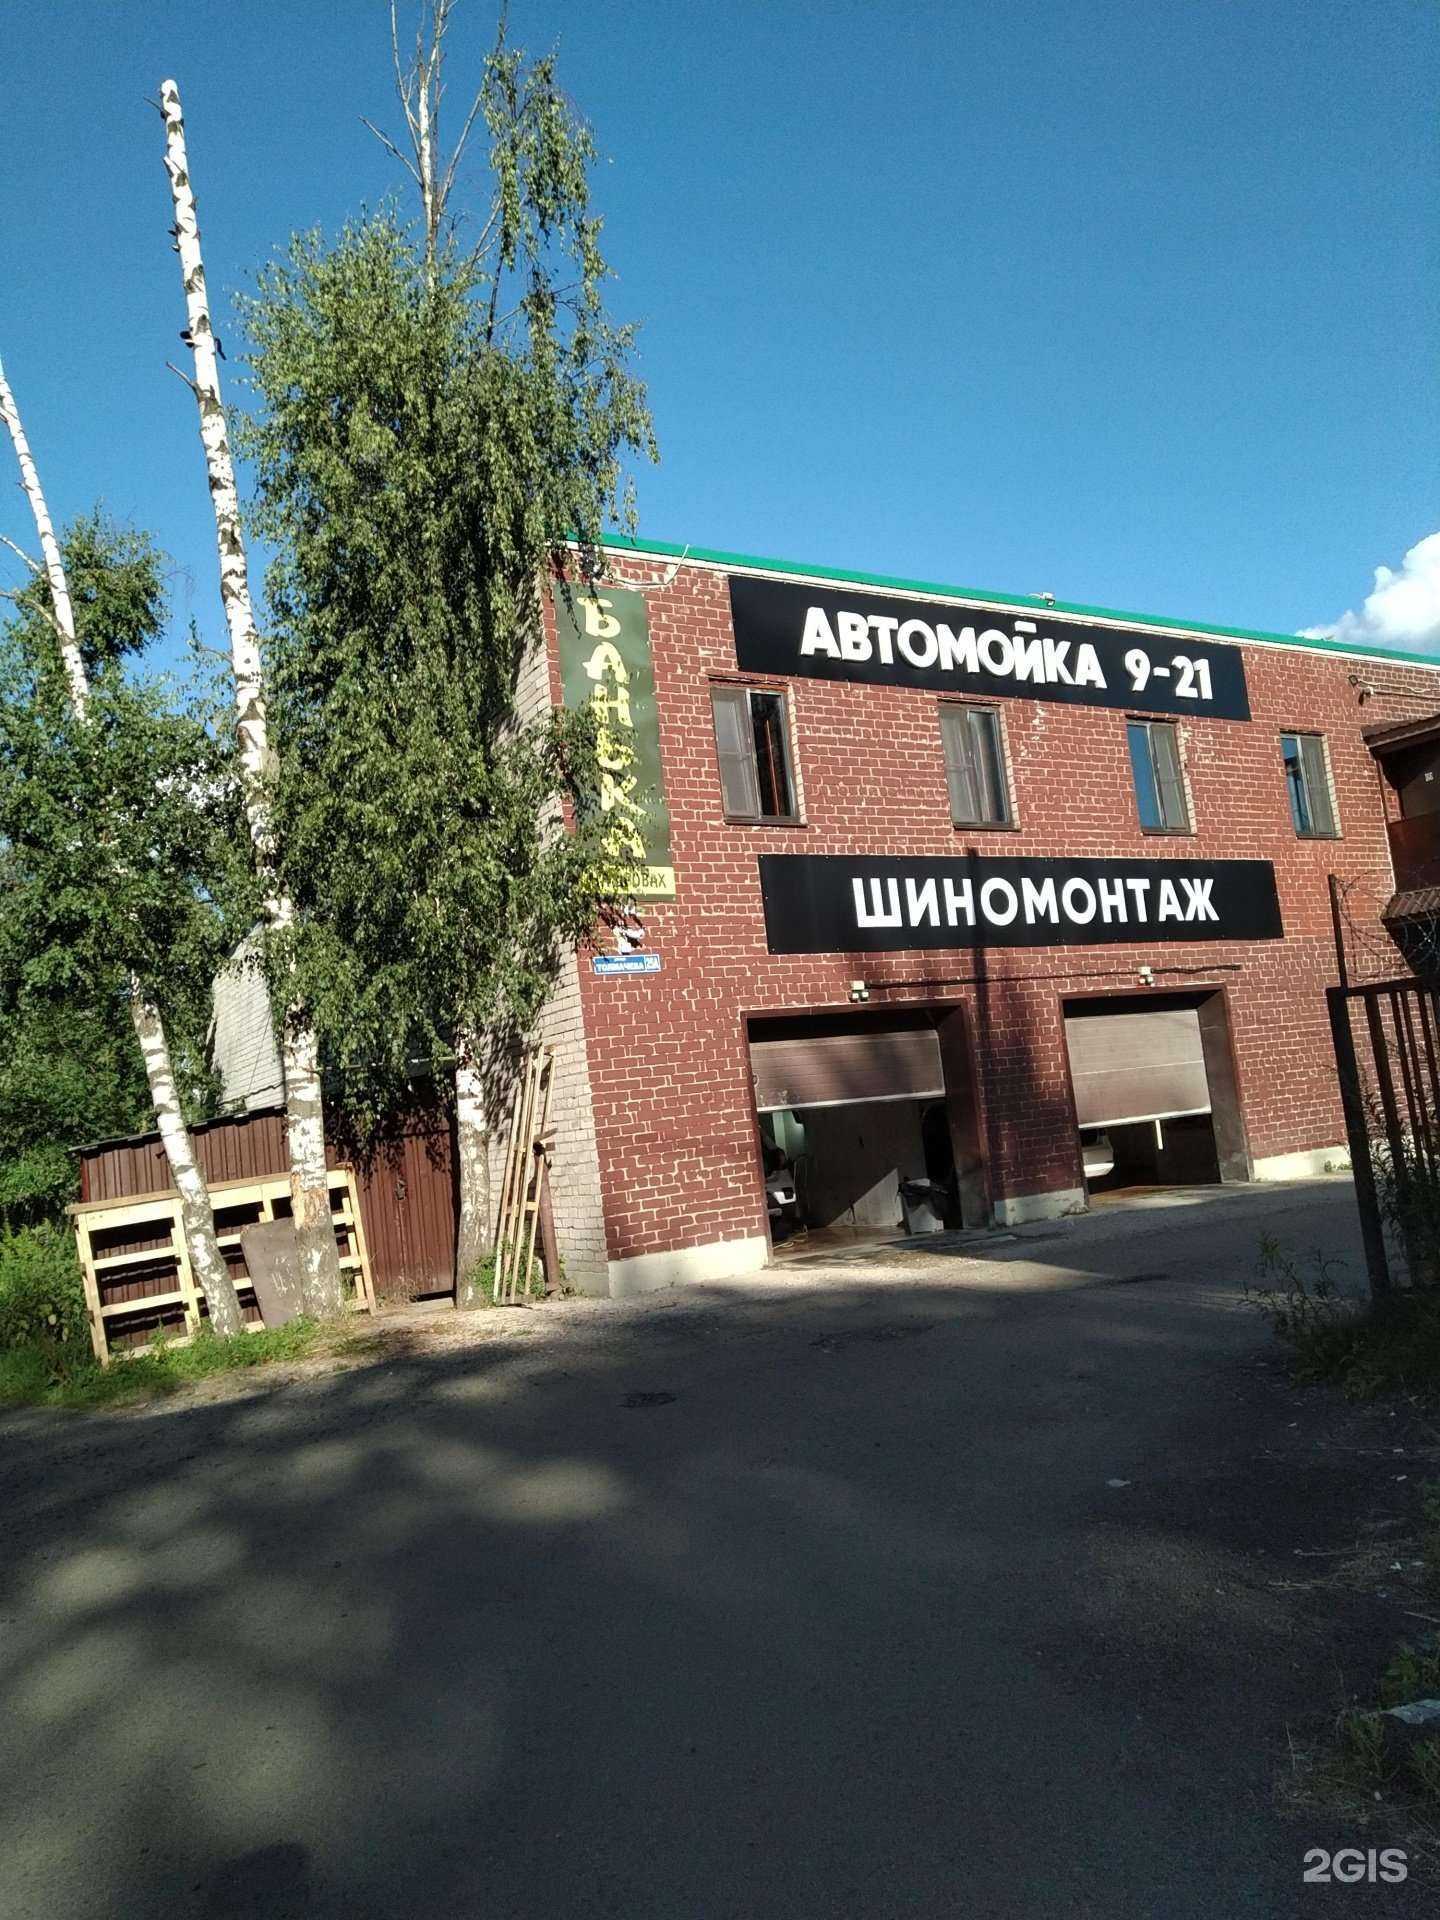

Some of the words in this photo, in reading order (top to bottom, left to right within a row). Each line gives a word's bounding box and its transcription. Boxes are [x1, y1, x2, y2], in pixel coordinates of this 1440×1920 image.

[800, 607, 1107, 689] АВТОМОЙКА
[1124, 648, 1213, 700] 9-21
[577, 596, 646, 859] БАНЬКА
[852, 877, 1220, 928] ШИНОМОНТАЖ
